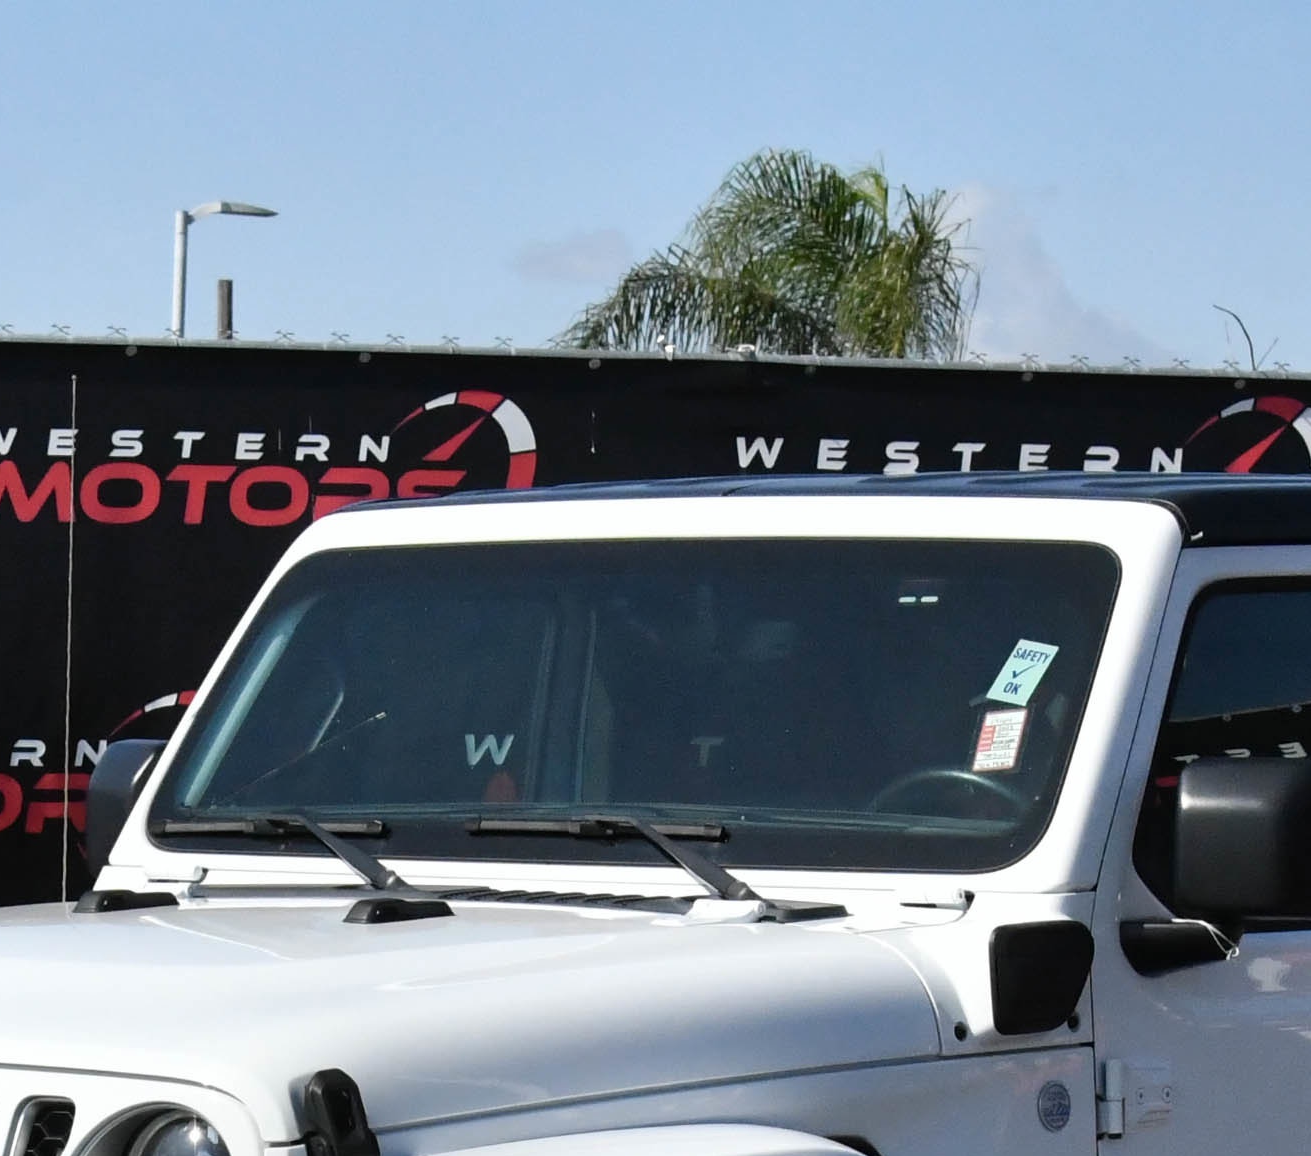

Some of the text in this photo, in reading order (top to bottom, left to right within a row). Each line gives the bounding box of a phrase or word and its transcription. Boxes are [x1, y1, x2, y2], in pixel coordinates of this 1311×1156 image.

[737, 437, 1183, 475] WESTERN
[1013, 647, 1051, 664] SAFETY
[1003, 681, 1023, 695] OK
